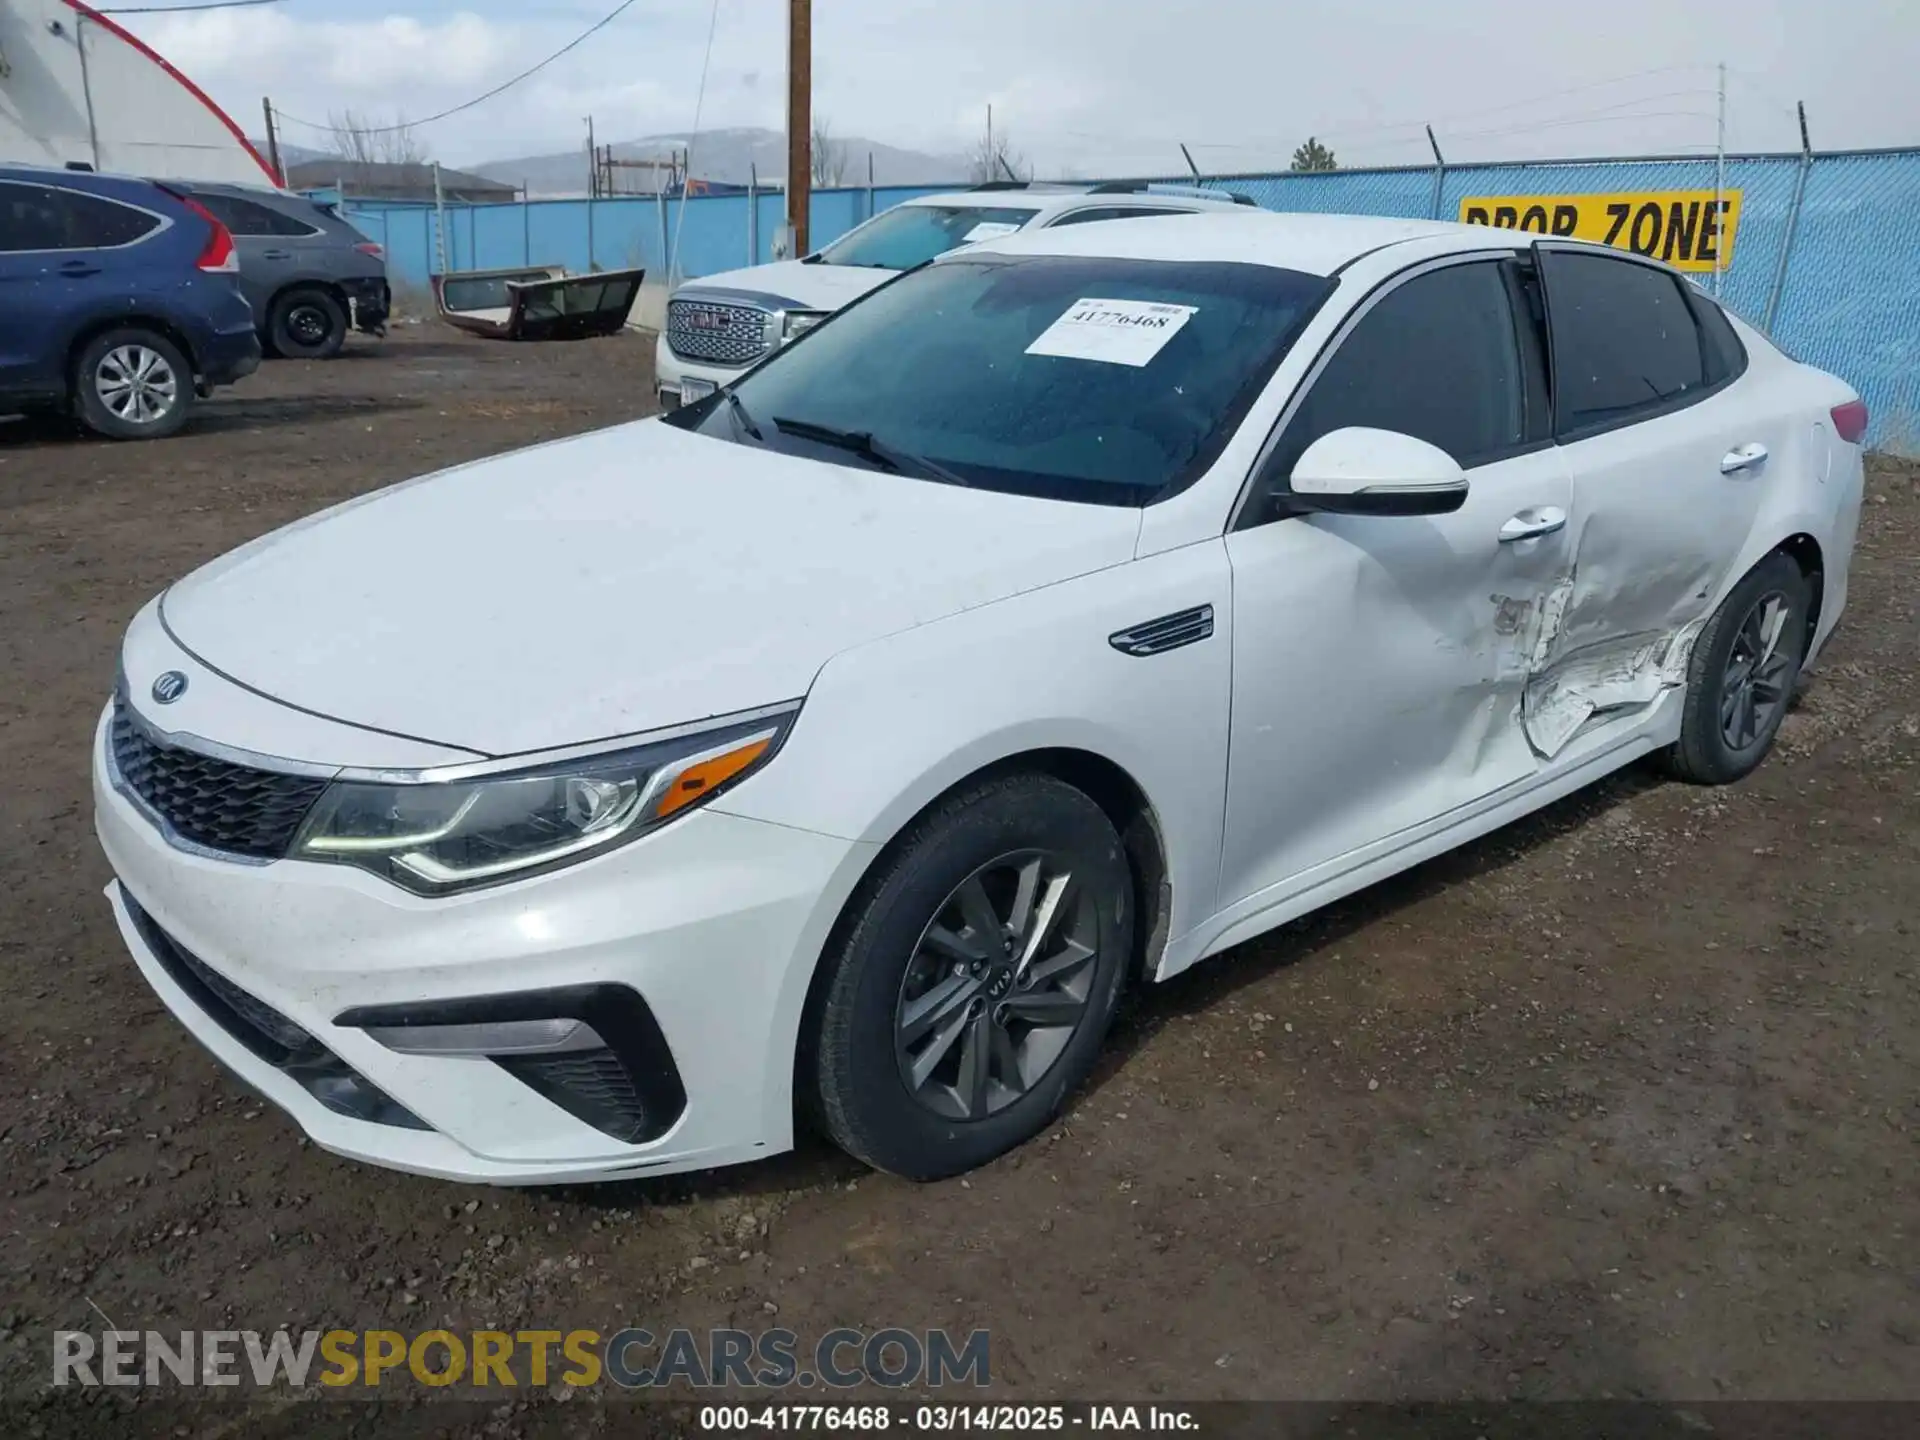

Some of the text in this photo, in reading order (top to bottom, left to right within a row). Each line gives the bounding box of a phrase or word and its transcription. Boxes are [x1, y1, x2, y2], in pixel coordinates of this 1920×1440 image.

[1603, 200, 1731, 261] ZONE
[690, 311, 730, 330] GMC
[1073, 311, 1170, 328] 41776468
